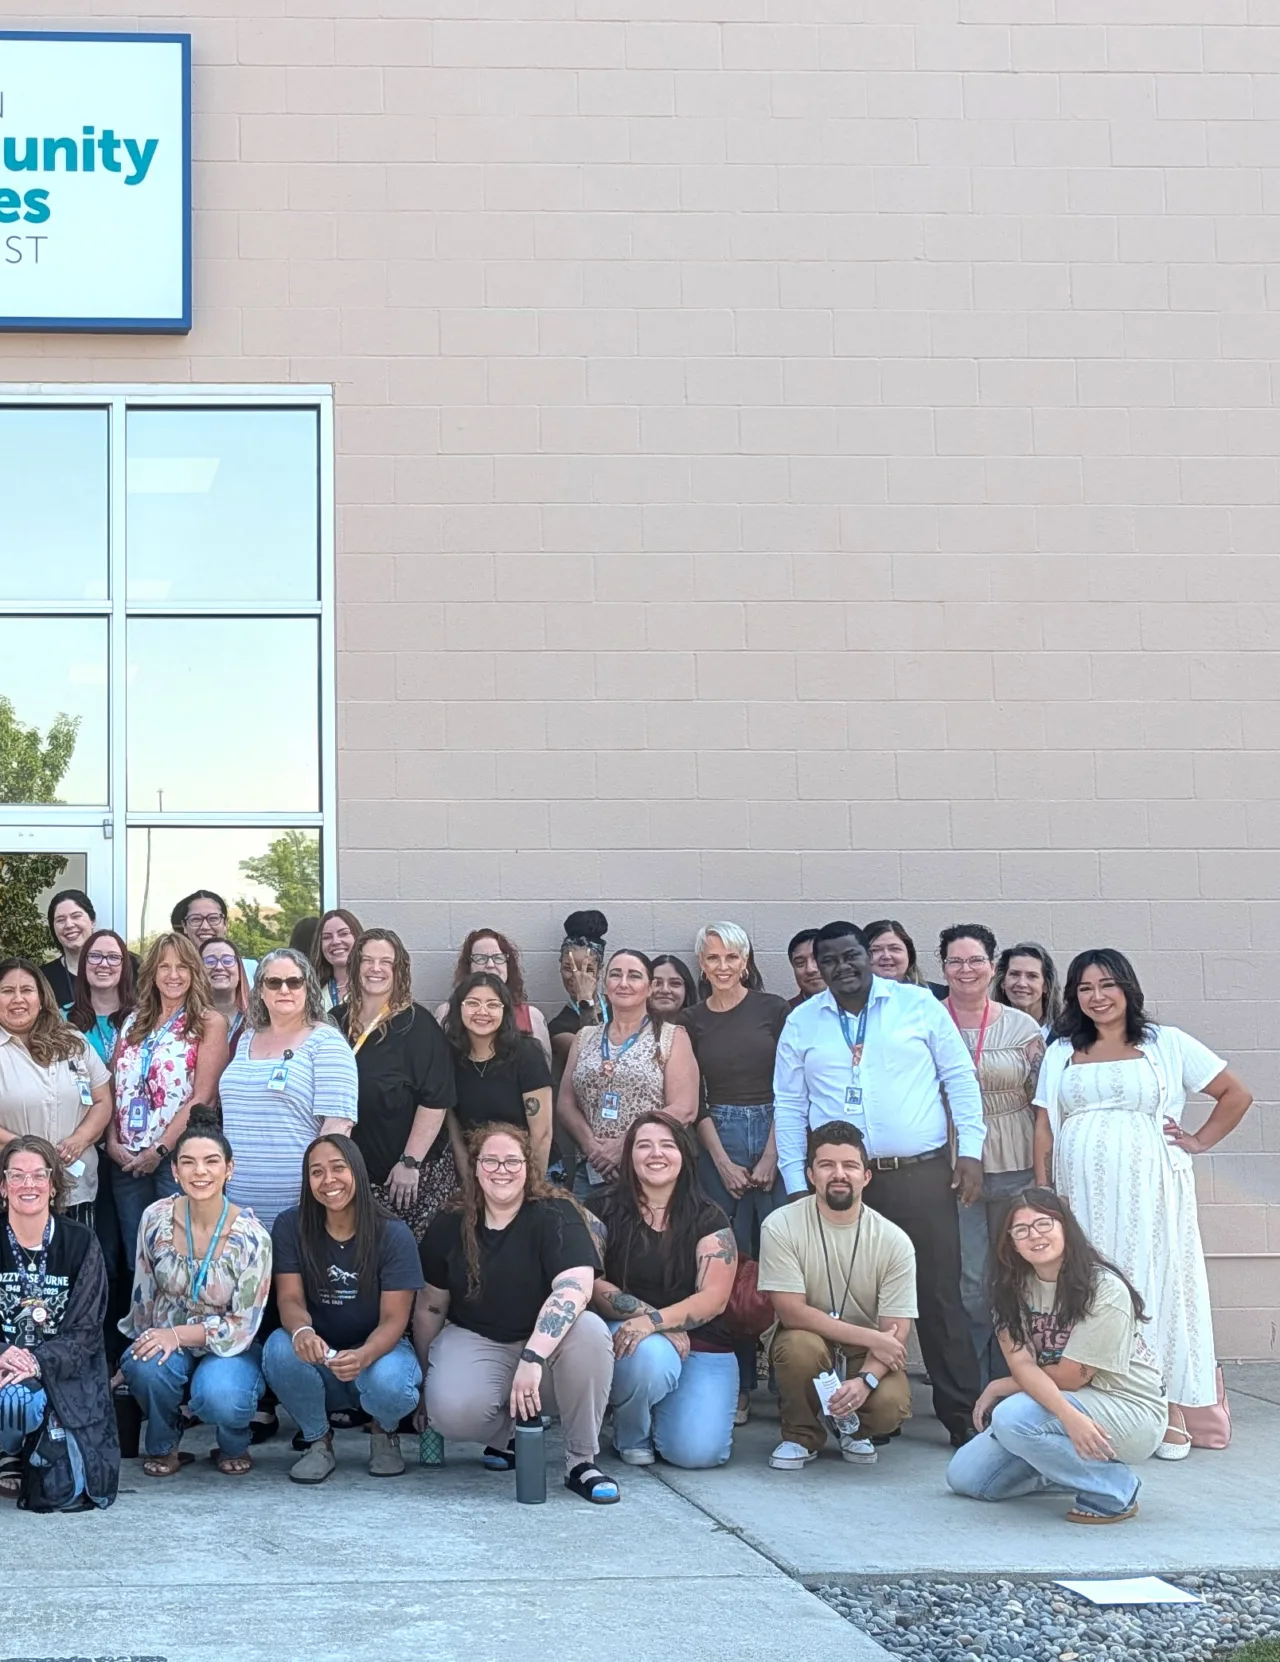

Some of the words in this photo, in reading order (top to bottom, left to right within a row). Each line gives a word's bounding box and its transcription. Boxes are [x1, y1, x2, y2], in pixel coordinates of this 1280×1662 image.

[26, 1273, 69, 1287] SURNE
[5, 1284, 21, 1293] 1948
[43, 1287, 59, 1295] 2025
